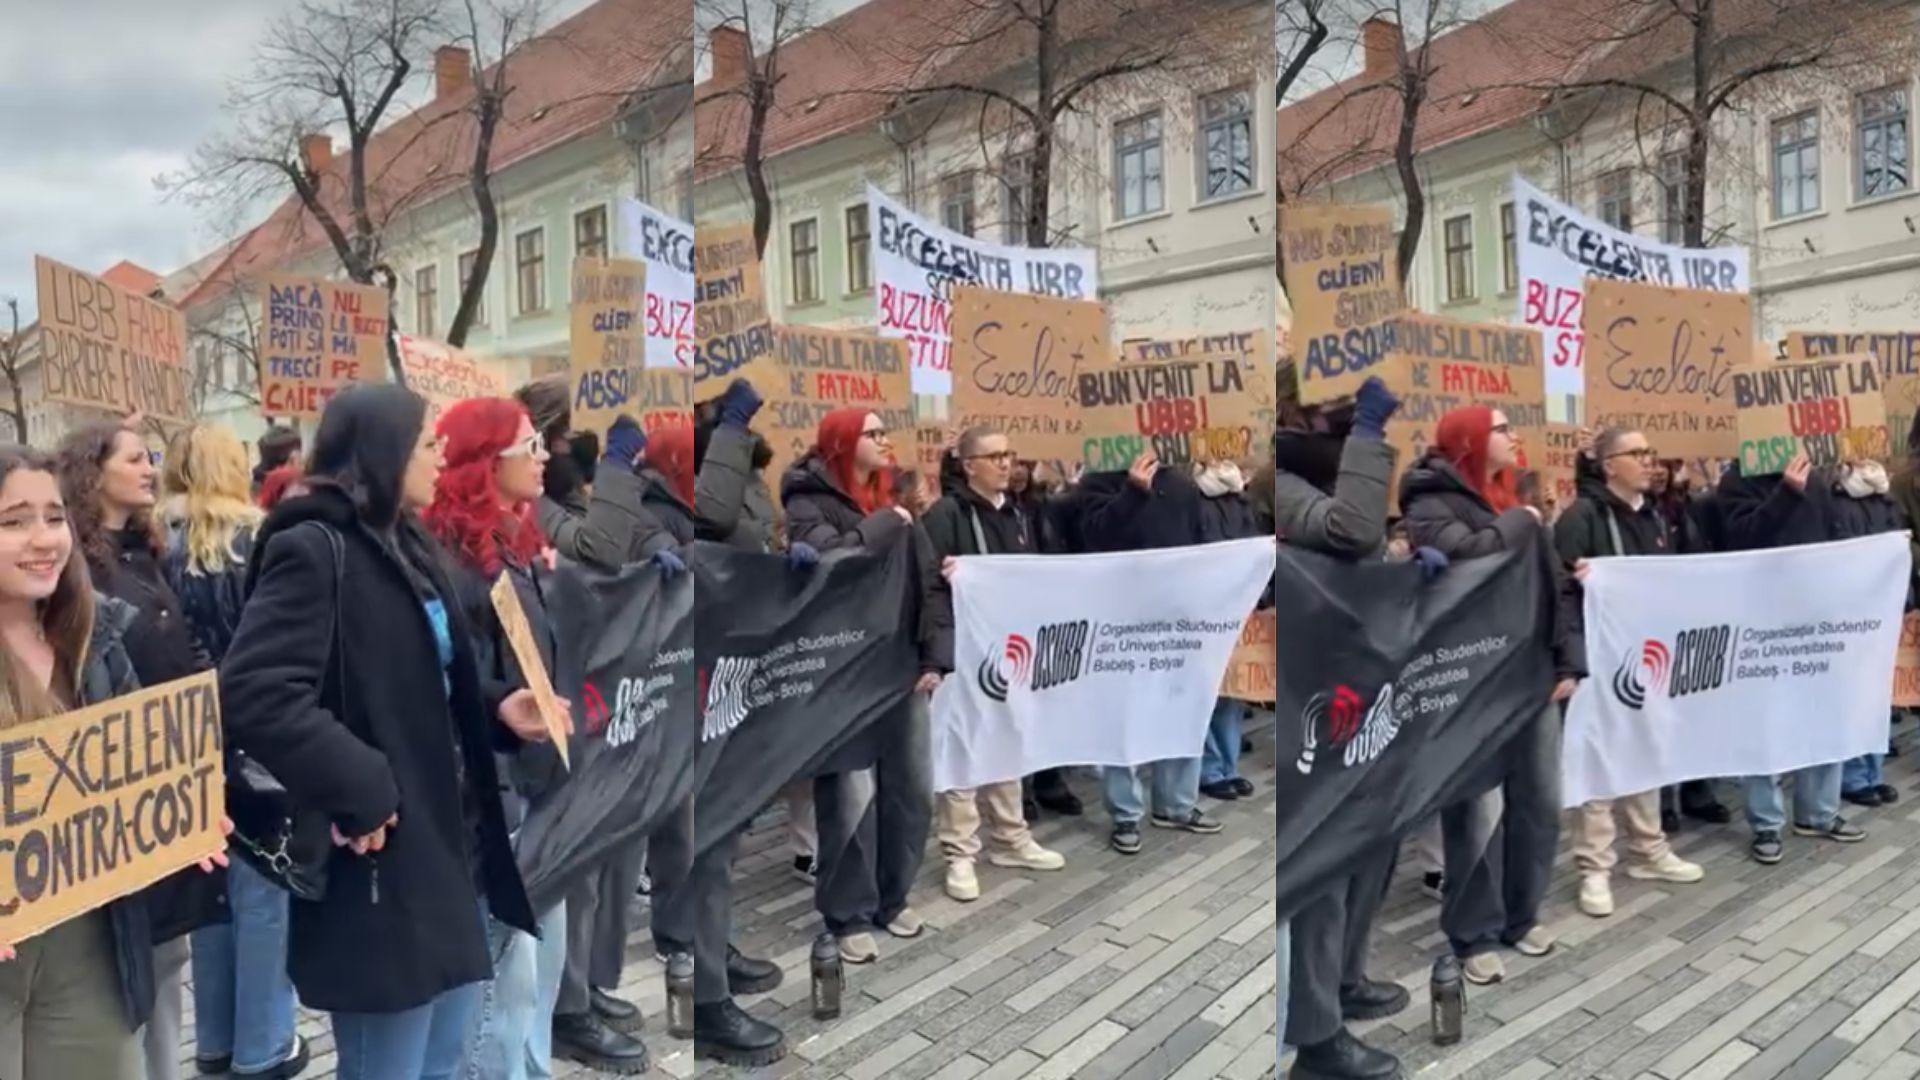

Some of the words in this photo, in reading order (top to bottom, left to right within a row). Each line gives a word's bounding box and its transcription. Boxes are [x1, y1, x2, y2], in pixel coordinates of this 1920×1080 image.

[1025, 260, 1084, 299] UBB
[51, 265, 119, 342] UBB
[269, 283, 323, 309] DACĂ
[333, 289, 362, 314] NU
[269, 305, 325, 330] PRIND
[330, 312, 347, 333] LA
[331, 359, 360, 380] PE
[1078, 370, 1132, 408] BUN
[1134, 363, 1199, 401] VENIT
[1207, 360, 1243, 394] LA
[1733, 369, 1784, 409] BUN
[1783, 363, 1842, 401] VENIT
[1847, 360, 1879, 394] LA
[1119, 637, 1203, 653] Universitatea
[1761, 640, 1846, 658] Universitatea
[1792, 658, 1830, 678] Bolyai
